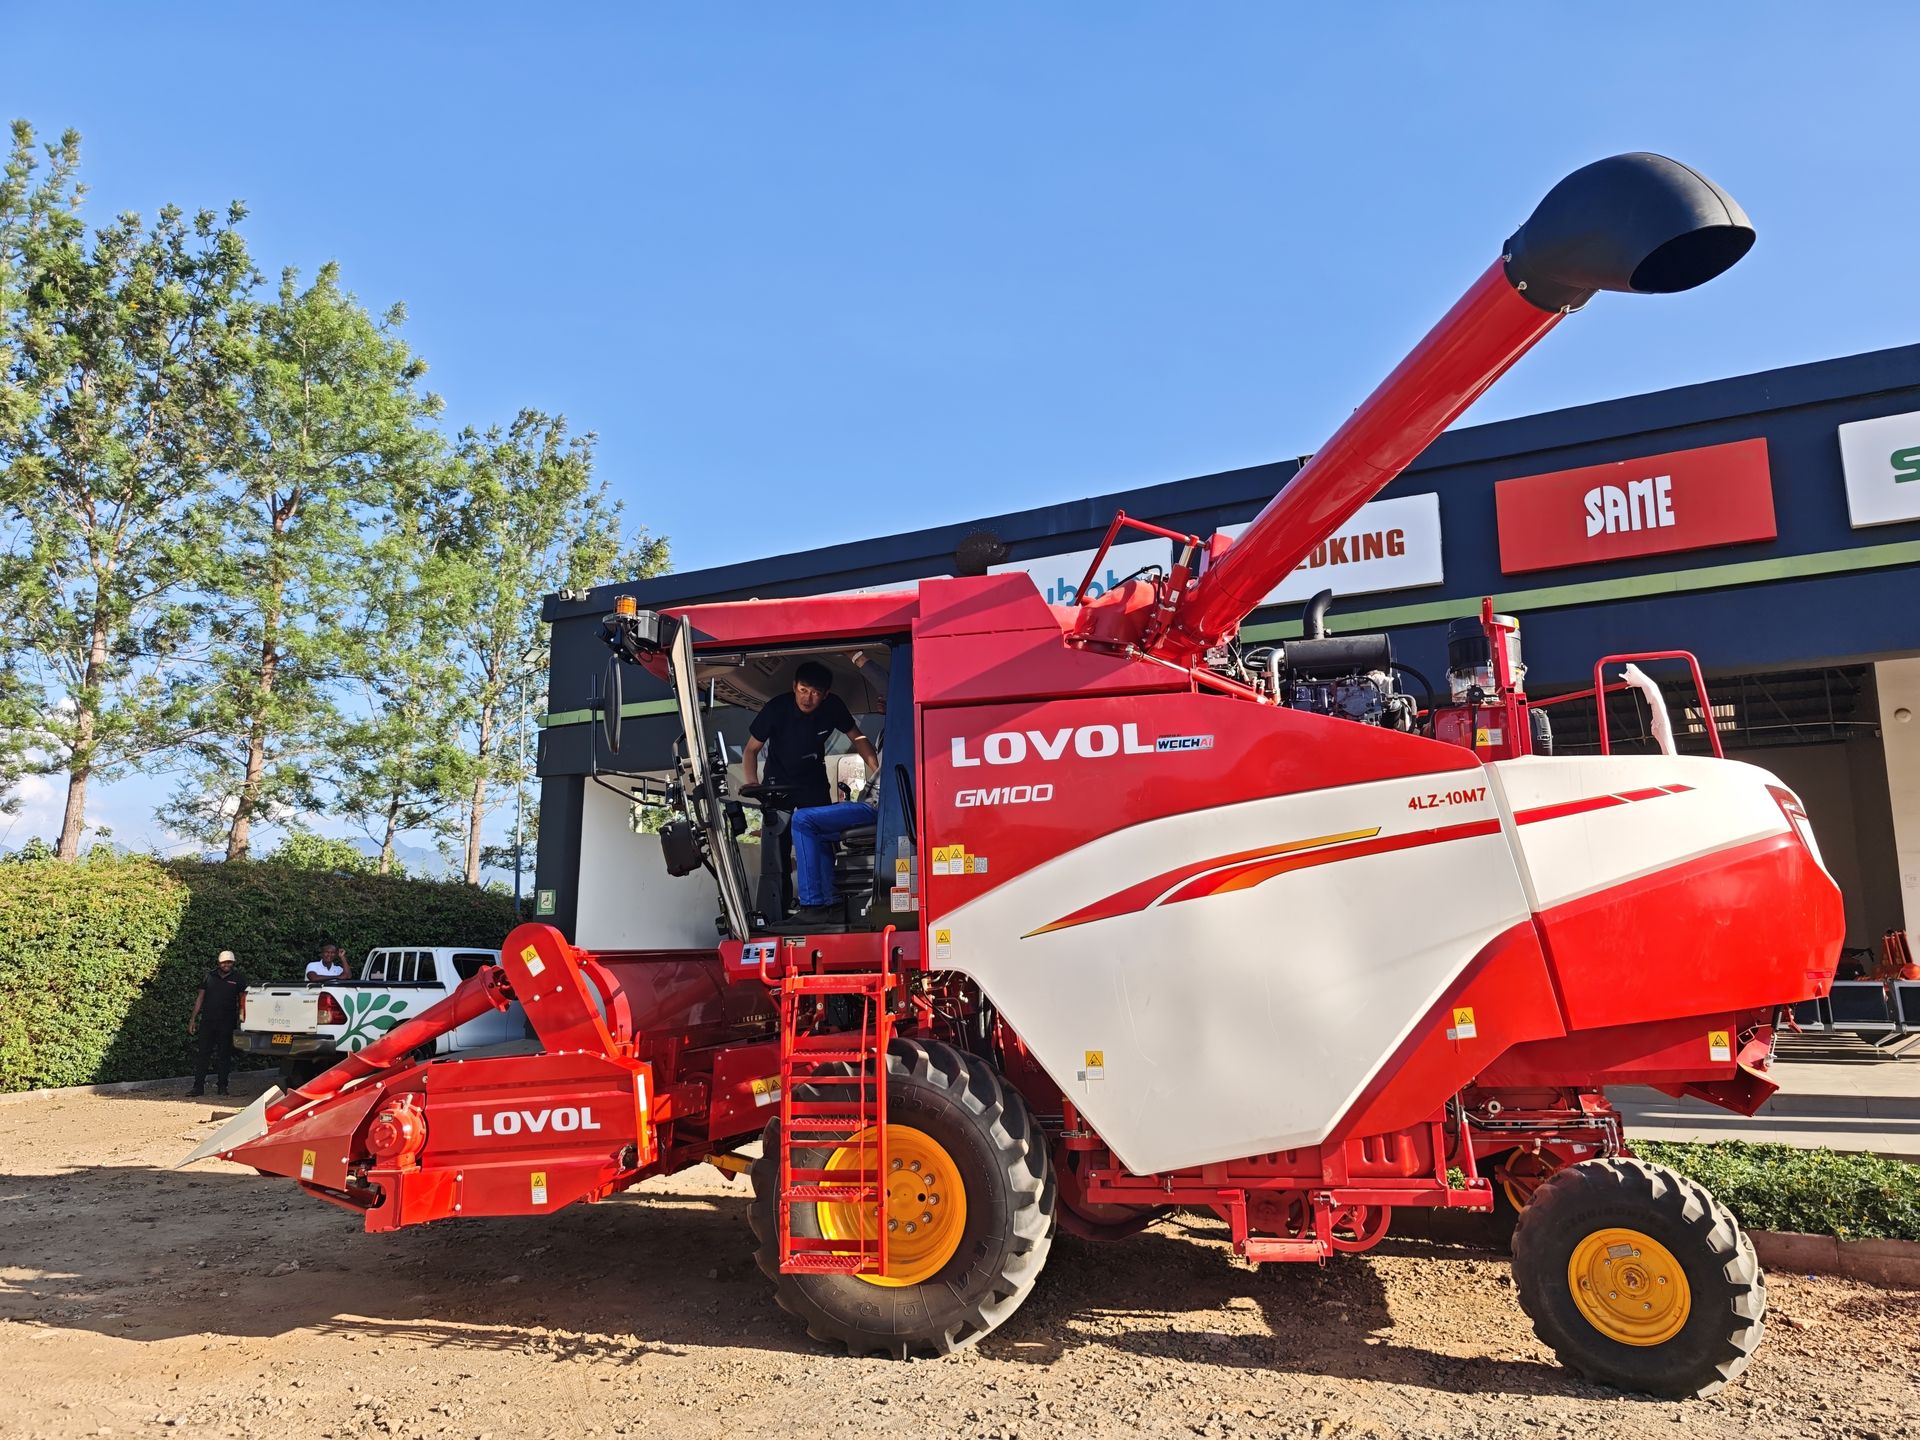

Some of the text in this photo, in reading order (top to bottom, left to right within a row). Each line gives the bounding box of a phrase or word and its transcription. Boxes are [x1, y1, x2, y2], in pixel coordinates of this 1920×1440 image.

[1583, 475, 1676, 537] SAME
[1296, 529, 1405, 570] DKING
[951, 723, 1154, 767] LOVOL
[955, 784, 1054, 808] GM100
[1408, 787, 1486, 810] 4LZ-10M7
[472, 1106, 601, 1137] LOVOL
